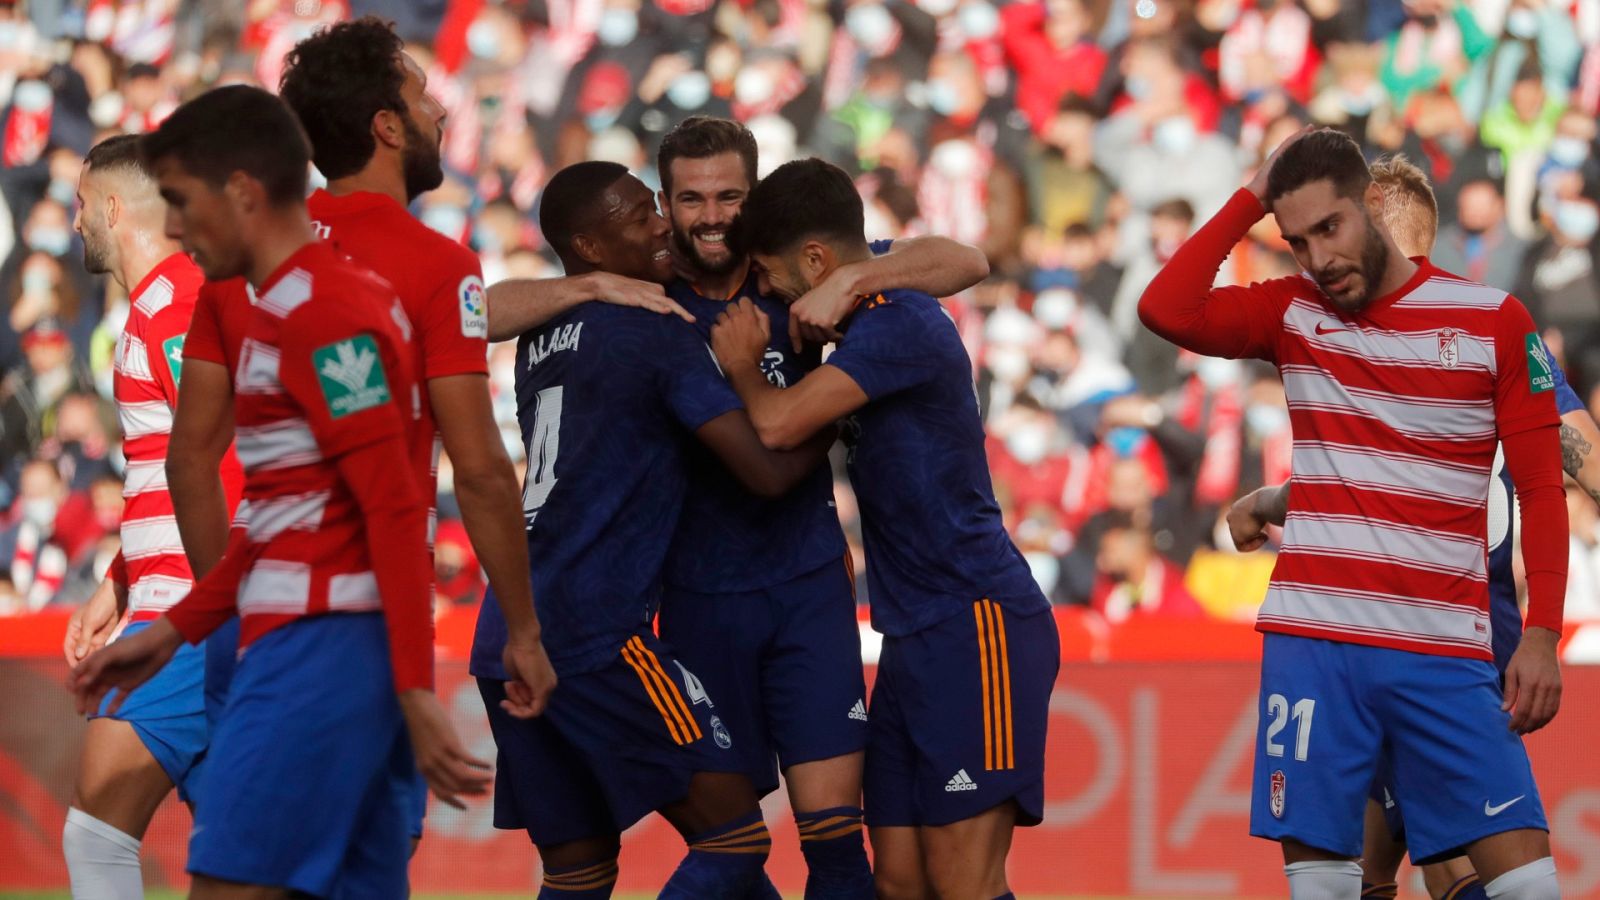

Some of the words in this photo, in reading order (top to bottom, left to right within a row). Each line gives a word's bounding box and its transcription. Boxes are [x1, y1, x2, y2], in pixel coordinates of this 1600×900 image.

[527, 321, 584, 371] ALABA
[673, 659, 715, 709] 4
[1266, 693, 1316, 762] 21
[944, 782, 978, 792] adidas
